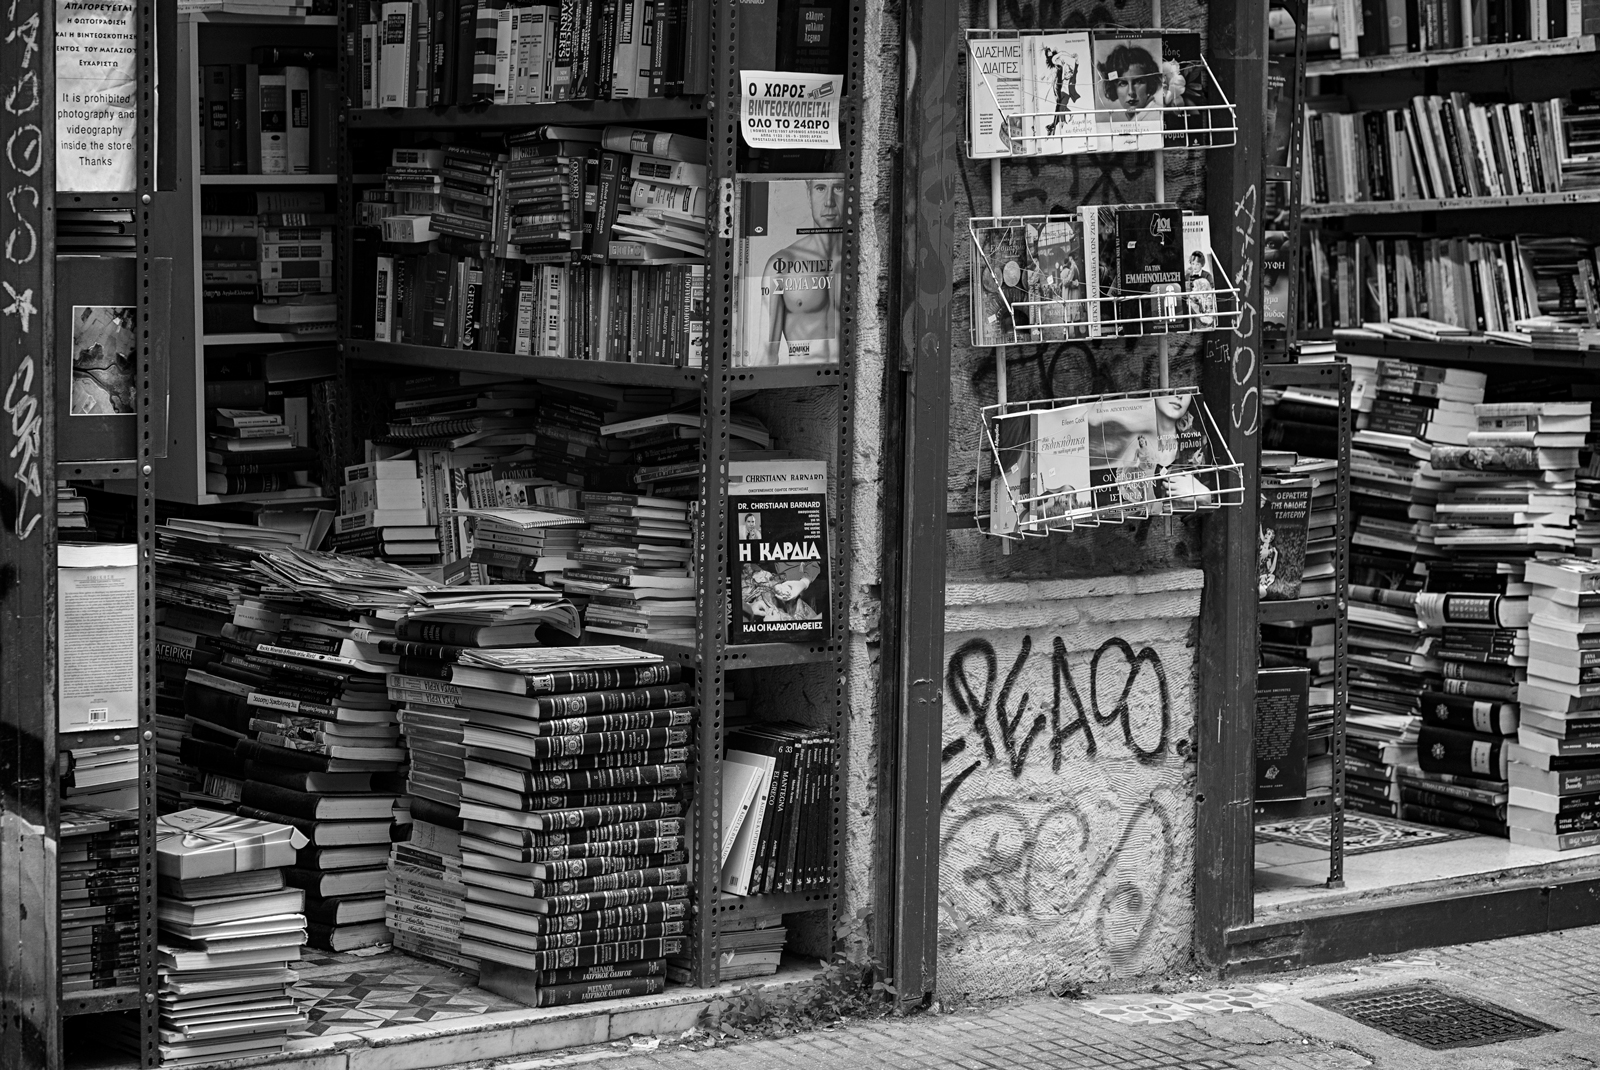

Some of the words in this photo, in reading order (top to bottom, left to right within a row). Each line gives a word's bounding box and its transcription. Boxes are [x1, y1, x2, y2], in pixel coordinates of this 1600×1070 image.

[64, 2, 132, 12] ΑΠΑΓΟΡΕΥΕΤΑΙ
[982, 62, 1018, 74] ΔΙΑΙΤΕΣ
[749, 82, 757, 96] Ο
[764, 83, 806, 98] ΧΩΡΟΣ
[62, 93, 69, 103] It
[72, 93, 81, 103] is
[84, 93, 130, 105] prohibited
[748, 100, 830, 118] ΒΙΝΤΕΟΣΚΟΠΕΙΤΑΙ
[58, 110, 114, 121] photography
[118, 110, 135, 119] and
[748, 118, 771, 128] ΟΛΟ
[775, 119, 790, 128] ΤΟ
[794, 119, 830, 129] 24ΩΡΟ
[66, 125, 123, 136] videography
[61, 141, 86, 150] inside
[90, 141, 104, 150] the
[108, 142, 135, 150] store.
[520, 147, 539, 158] GREEK
[79, 156, 112, 166] Thanks
[1156, 218, 1171, 229] 101
[773, 258, 834, 274] ΦΡΟΝΤΙΣΕ
[1125, 271, 1181, 284] ΕΜΜΗΝΟΠΑΥΣΗ
[761, 287, 770, 296] ΤΟ
[772, 276, 809, 295] ΣΩΜΑ
[811, 276, 834, 290] ΣΟΥ
[465, 285, 476, 335] GERMAN
[508, 469, 535, 479] ΟΙΚΟΓΕ
[745, 474, 787, 483] CHRISTIANN
[1102, 474, 1112, 482] ΟΙ
[1276, 492, 1282, 500] Ο
[1282, 491, 1308, 499] ΕΡΑΣΤΗΣ
[738, 502, 749, 510] DR.
[1271, 502, 1282, 510] ΤΗΣ
[1283, 501, 1307, 509] ΛΑΙΔΗΣ
[1275, 511, 1306, 519] ΤΣΑΤΕΡΛΥ
[739, 543, 751, 562] Η
[760, 541, 821, 561] ΚΑΡΔΙΑ
[743, 624, 756, 633] ΚΑΙ
[757, 623, 766, 631] ΟΙ
[766, 621, 823, 631] ΚΑΡΔΙΟΠΑΘΕΙΕΣ
[156, 644, 192, 661] ΑΓΕΙΡΙΚΗ
[773, 771, 780, 780] EL
[778, 771, 789, 812] MANTEGNA
[1565, 782, 1582, 790] Donnelly
[769, 782, 778, 805] GRECO
